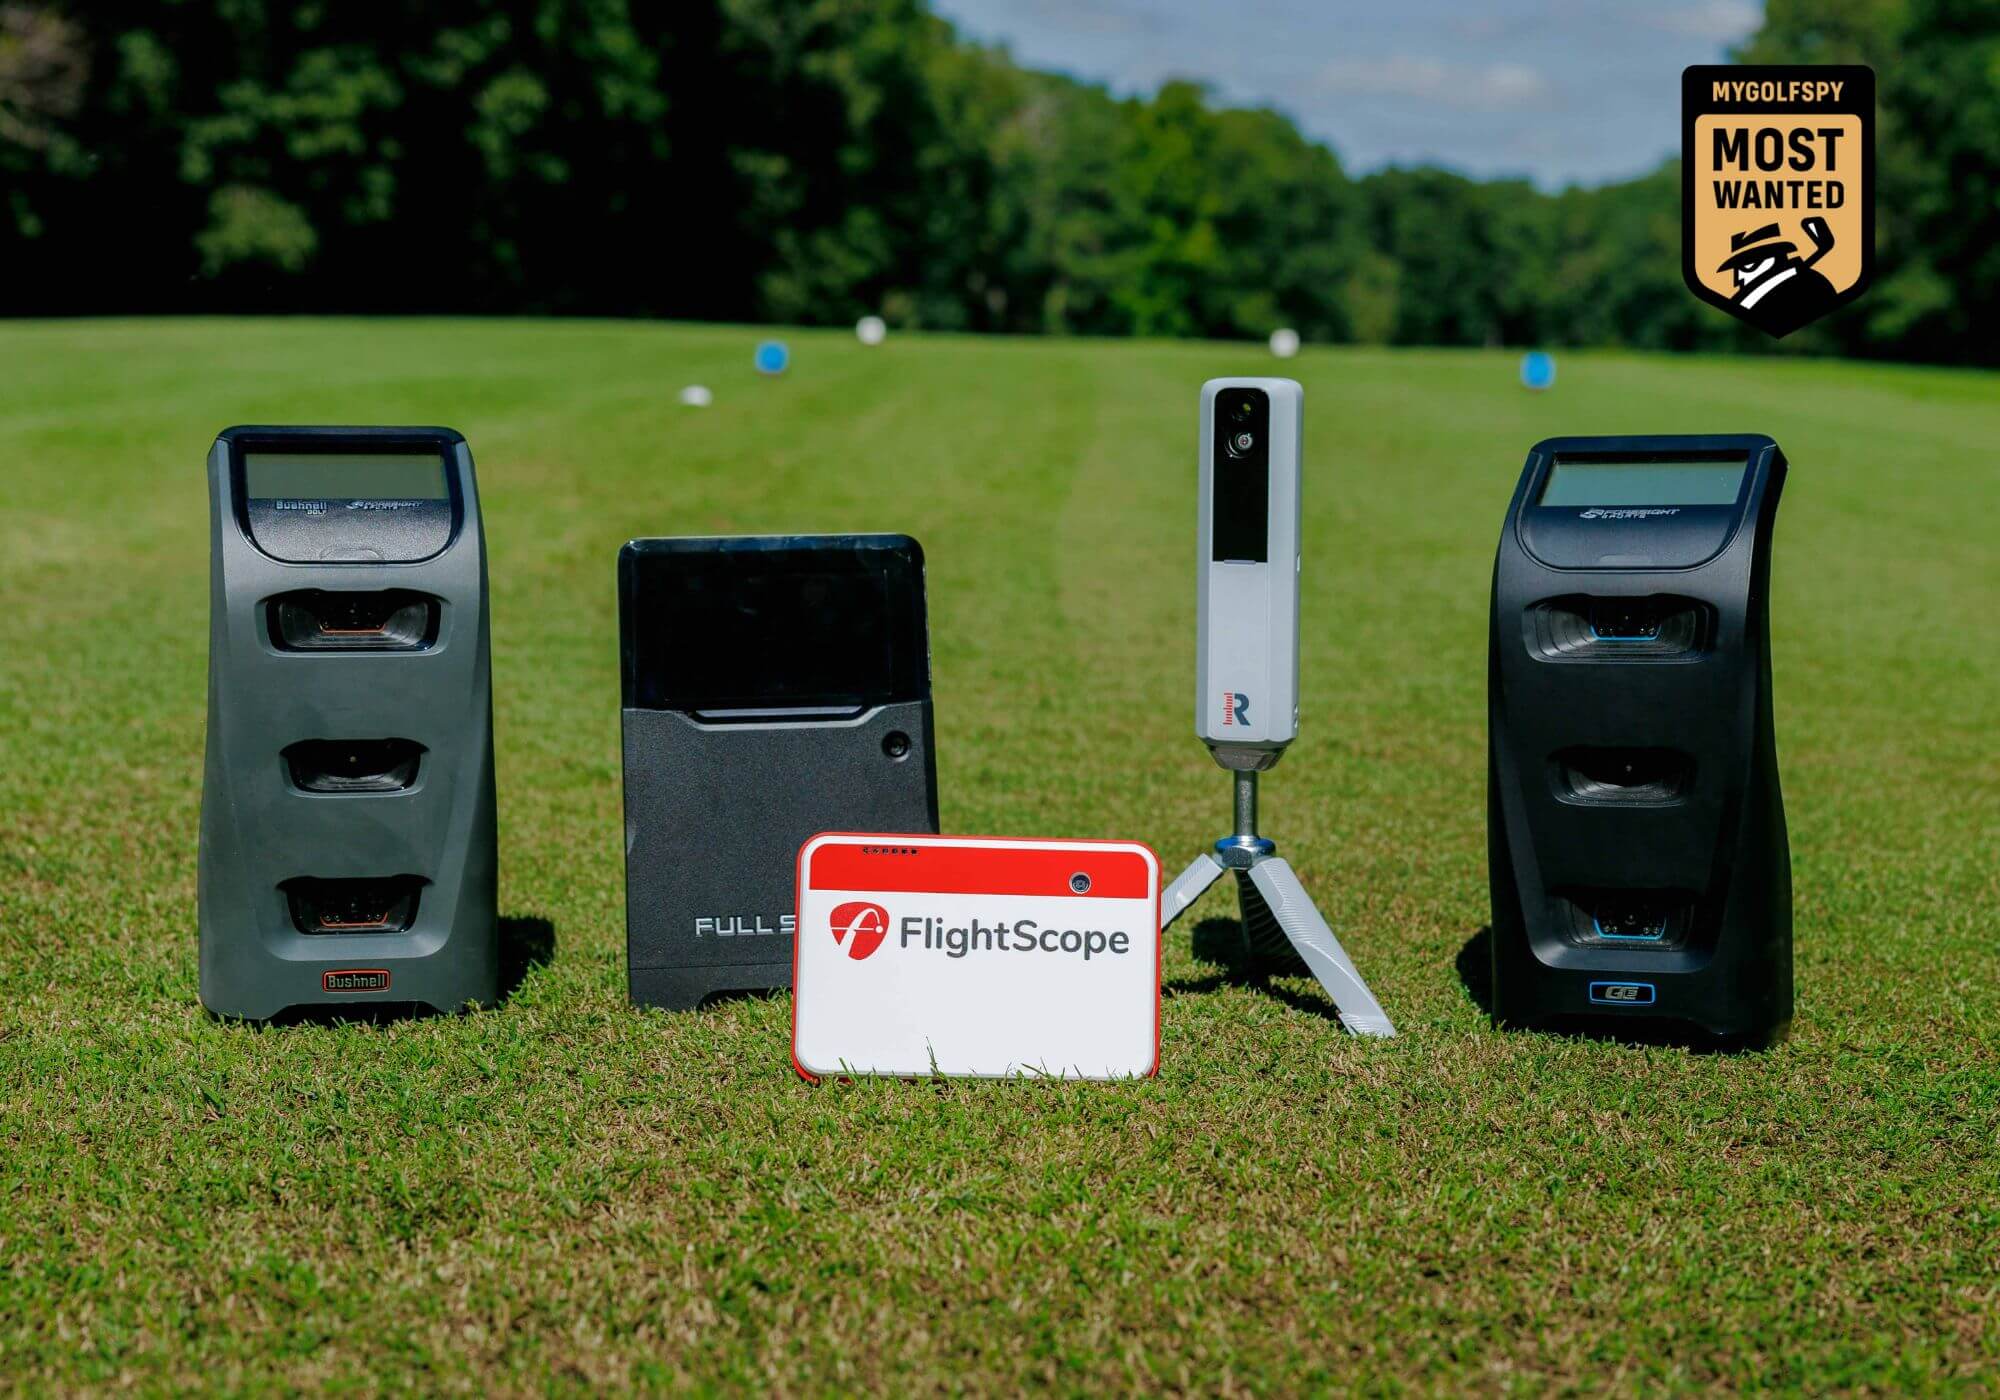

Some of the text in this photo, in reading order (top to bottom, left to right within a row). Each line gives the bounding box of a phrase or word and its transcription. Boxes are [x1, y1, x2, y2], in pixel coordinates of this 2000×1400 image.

[276, 501, 327, 510] Bushnell
[695, 916, 773, 937] FULL
[900, 916, 1130, 961] FlightScope
[328, 975, 386, 988] Bushnell
